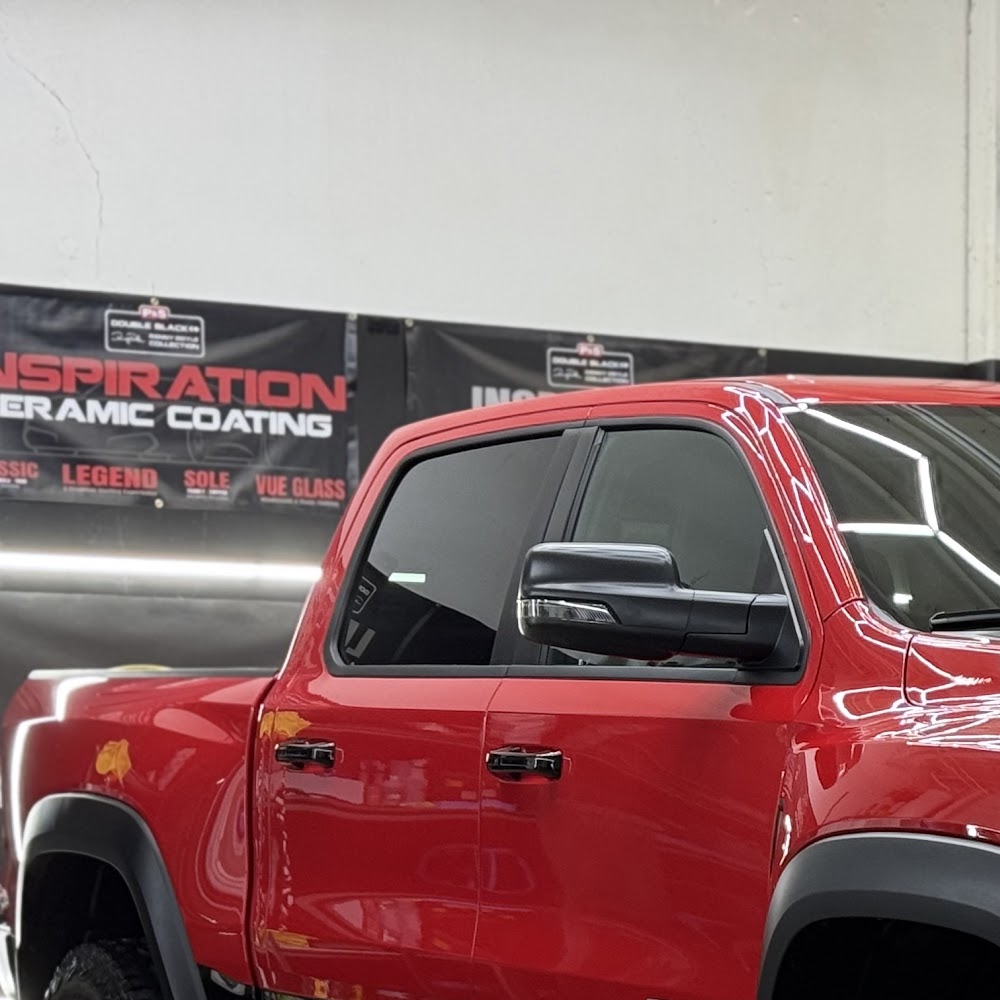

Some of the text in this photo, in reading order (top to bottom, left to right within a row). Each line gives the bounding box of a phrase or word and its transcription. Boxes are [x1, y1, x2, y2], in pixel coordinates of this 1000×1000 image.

[167, 405, 332, 438] COATING
[62, 463, 158, 489] LEGEND
[183, 469, 230, 489] SOLE
[256, 473, 346, 499] VUE GLASS
